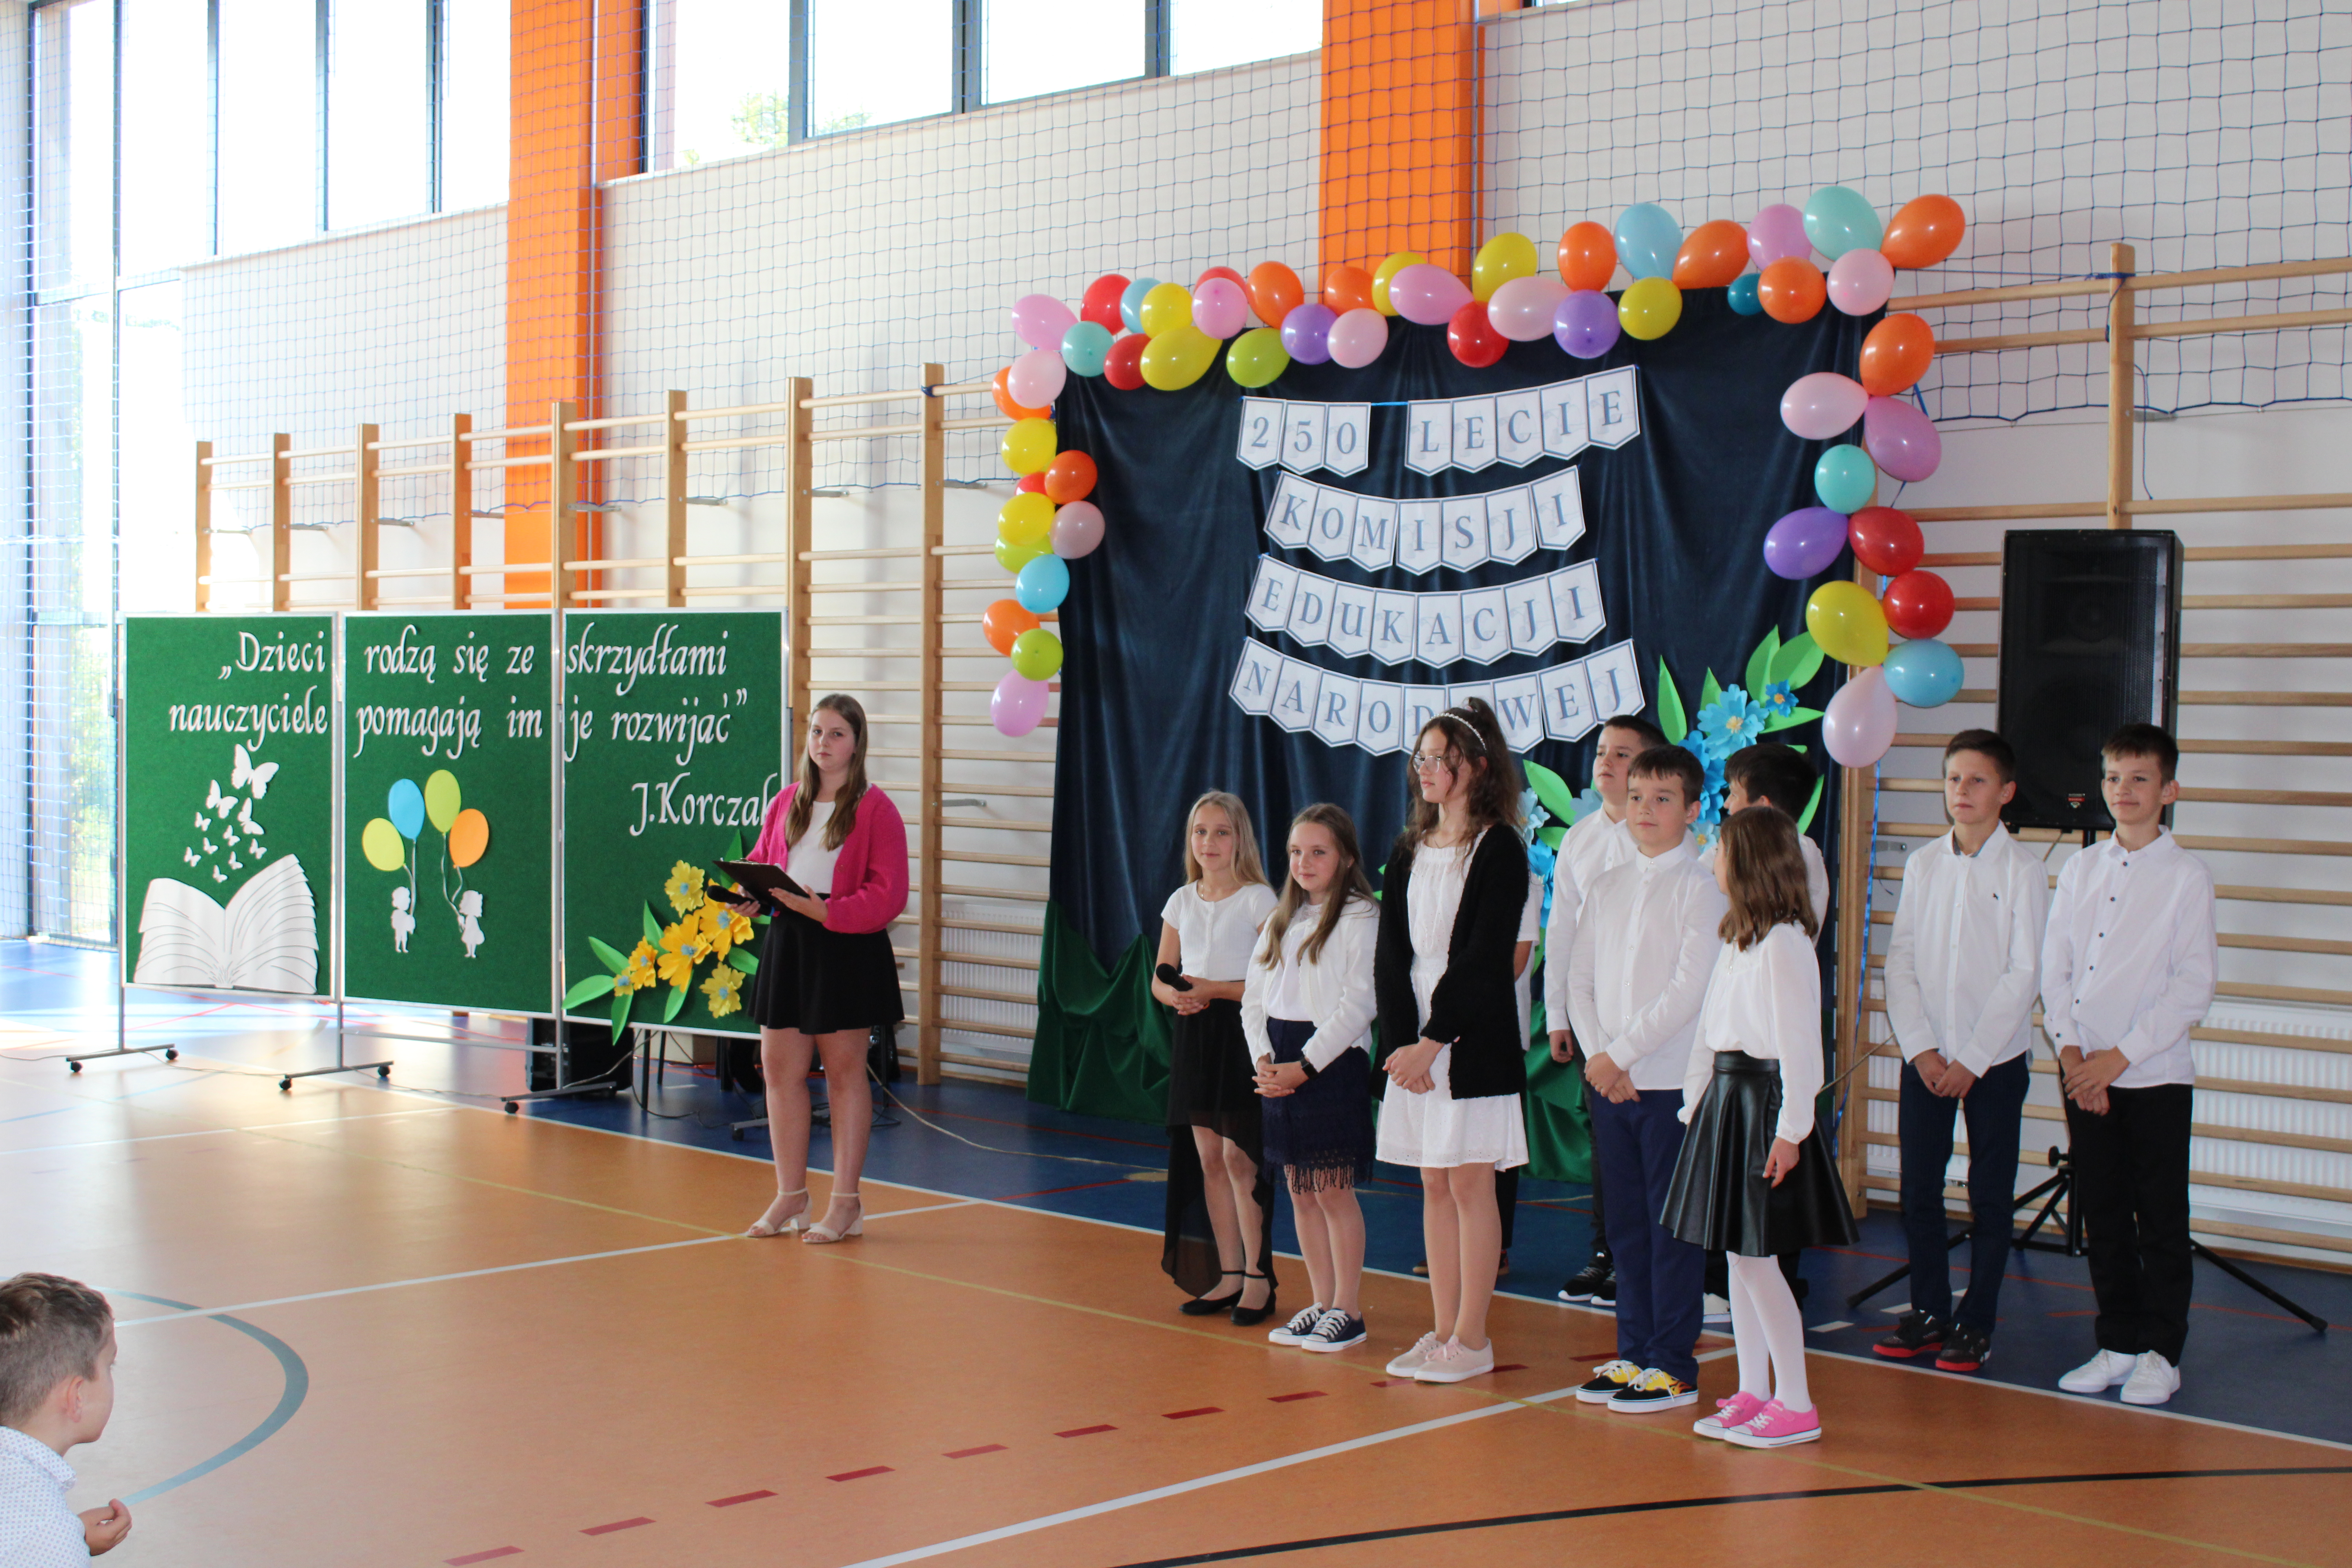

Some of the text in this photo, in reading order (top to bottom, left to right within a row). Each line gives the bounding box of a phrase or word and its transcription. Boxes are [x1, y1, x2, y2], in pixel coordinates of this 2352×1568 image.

[1252, 390, 1623, 454] 250 LECIE
[1279, 493, 1568, 551] KOMISJI
[1261, 577, 1586, 645] EDUKACJI
[218, 622, 728, 696] „Dzieci rodzą się ze skrzydłami
[168, 685, 328, 755] nauczyciele
[353, 695, 481, 760] pomagają
[506, 695, 542, 738] im
[563, 695, 593, 762] je
[1241, 660, 1623, 735] NARODWEJ
